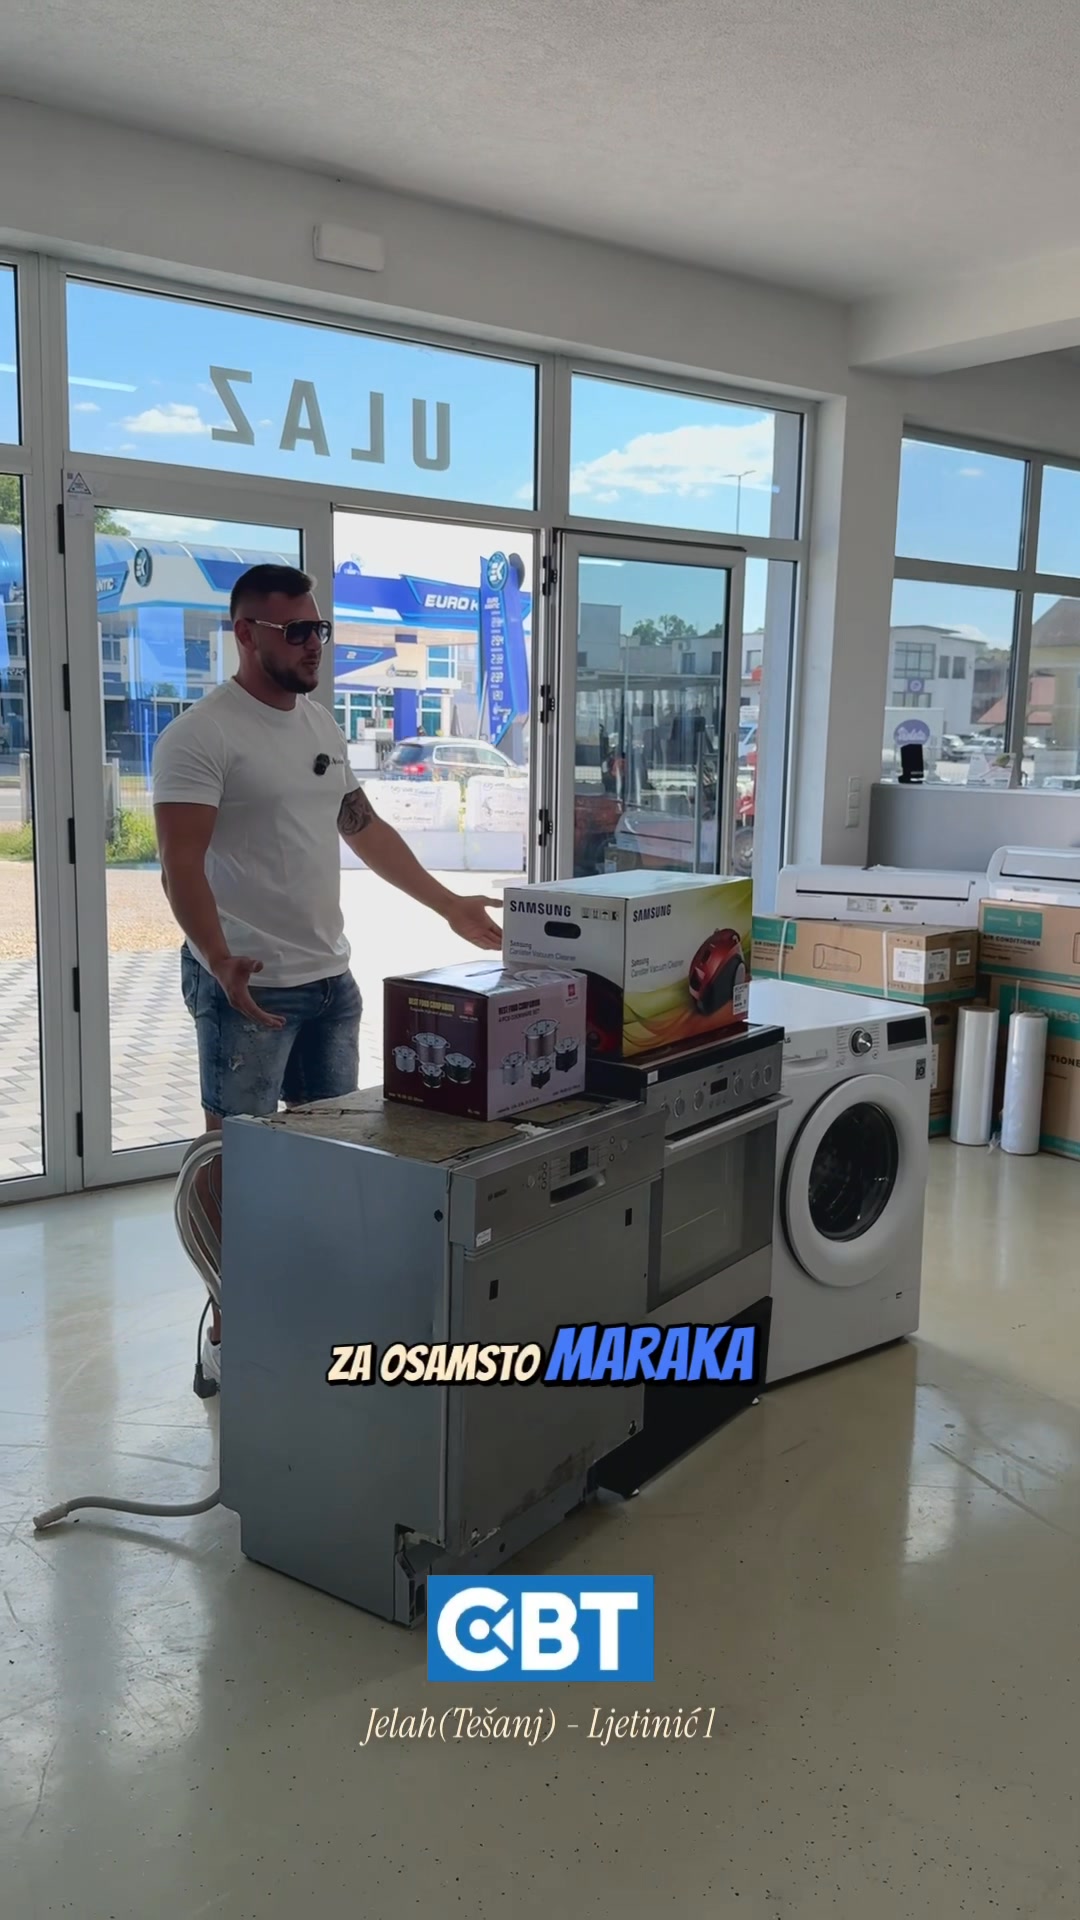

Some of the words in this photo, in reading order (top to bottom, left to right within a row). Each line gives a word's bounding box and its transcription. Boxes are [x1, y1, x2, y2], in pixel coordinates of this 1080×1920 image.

[424, 593, 469, 611] EURO
[510, 900, 571, 917] SAMSUNG
[632, 904, 672, 922] SAMSUNG
[510, 939, 532, 950] Samsung
[509, 947, 532, 956] Canister
[532, 949, 554, 959] Vacuum
[555, 952, 576, 961] Cleaner
[631, 957, 649, 968] Samsung
[631, 966, 649, 978] Canister
[649, 963, 667, 974] Vacuum
[667, 959, 684, 970] Cleaner
